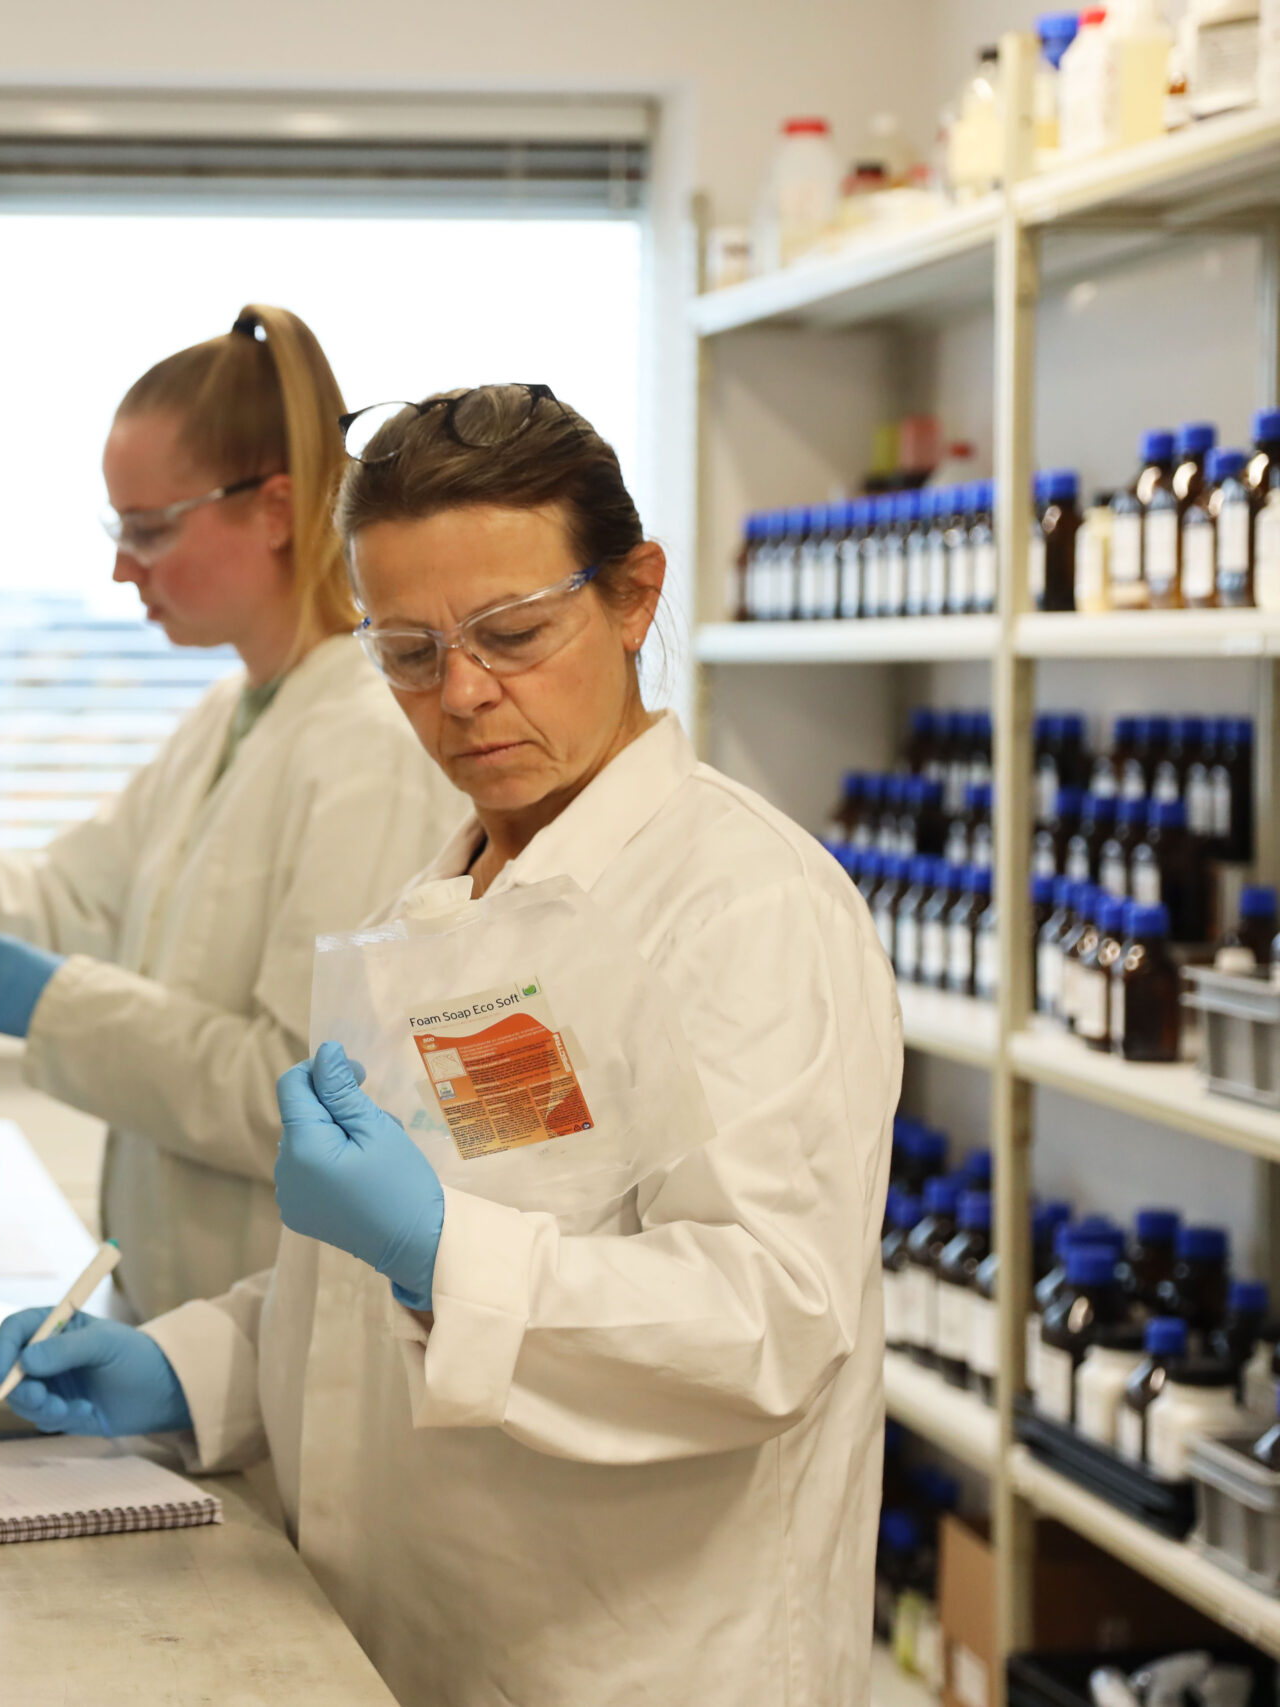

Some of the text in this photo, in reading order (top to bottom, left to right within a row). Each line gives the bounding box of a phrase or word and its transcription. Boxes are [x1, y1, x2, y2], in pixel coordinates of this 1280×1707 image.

[409, 1015, 442, 1028] Foam
[442, 1008, 472, 1022] Soap
[472, 1002, 495, 1015] Eco
[495, 993, 520, 1008] Soft
